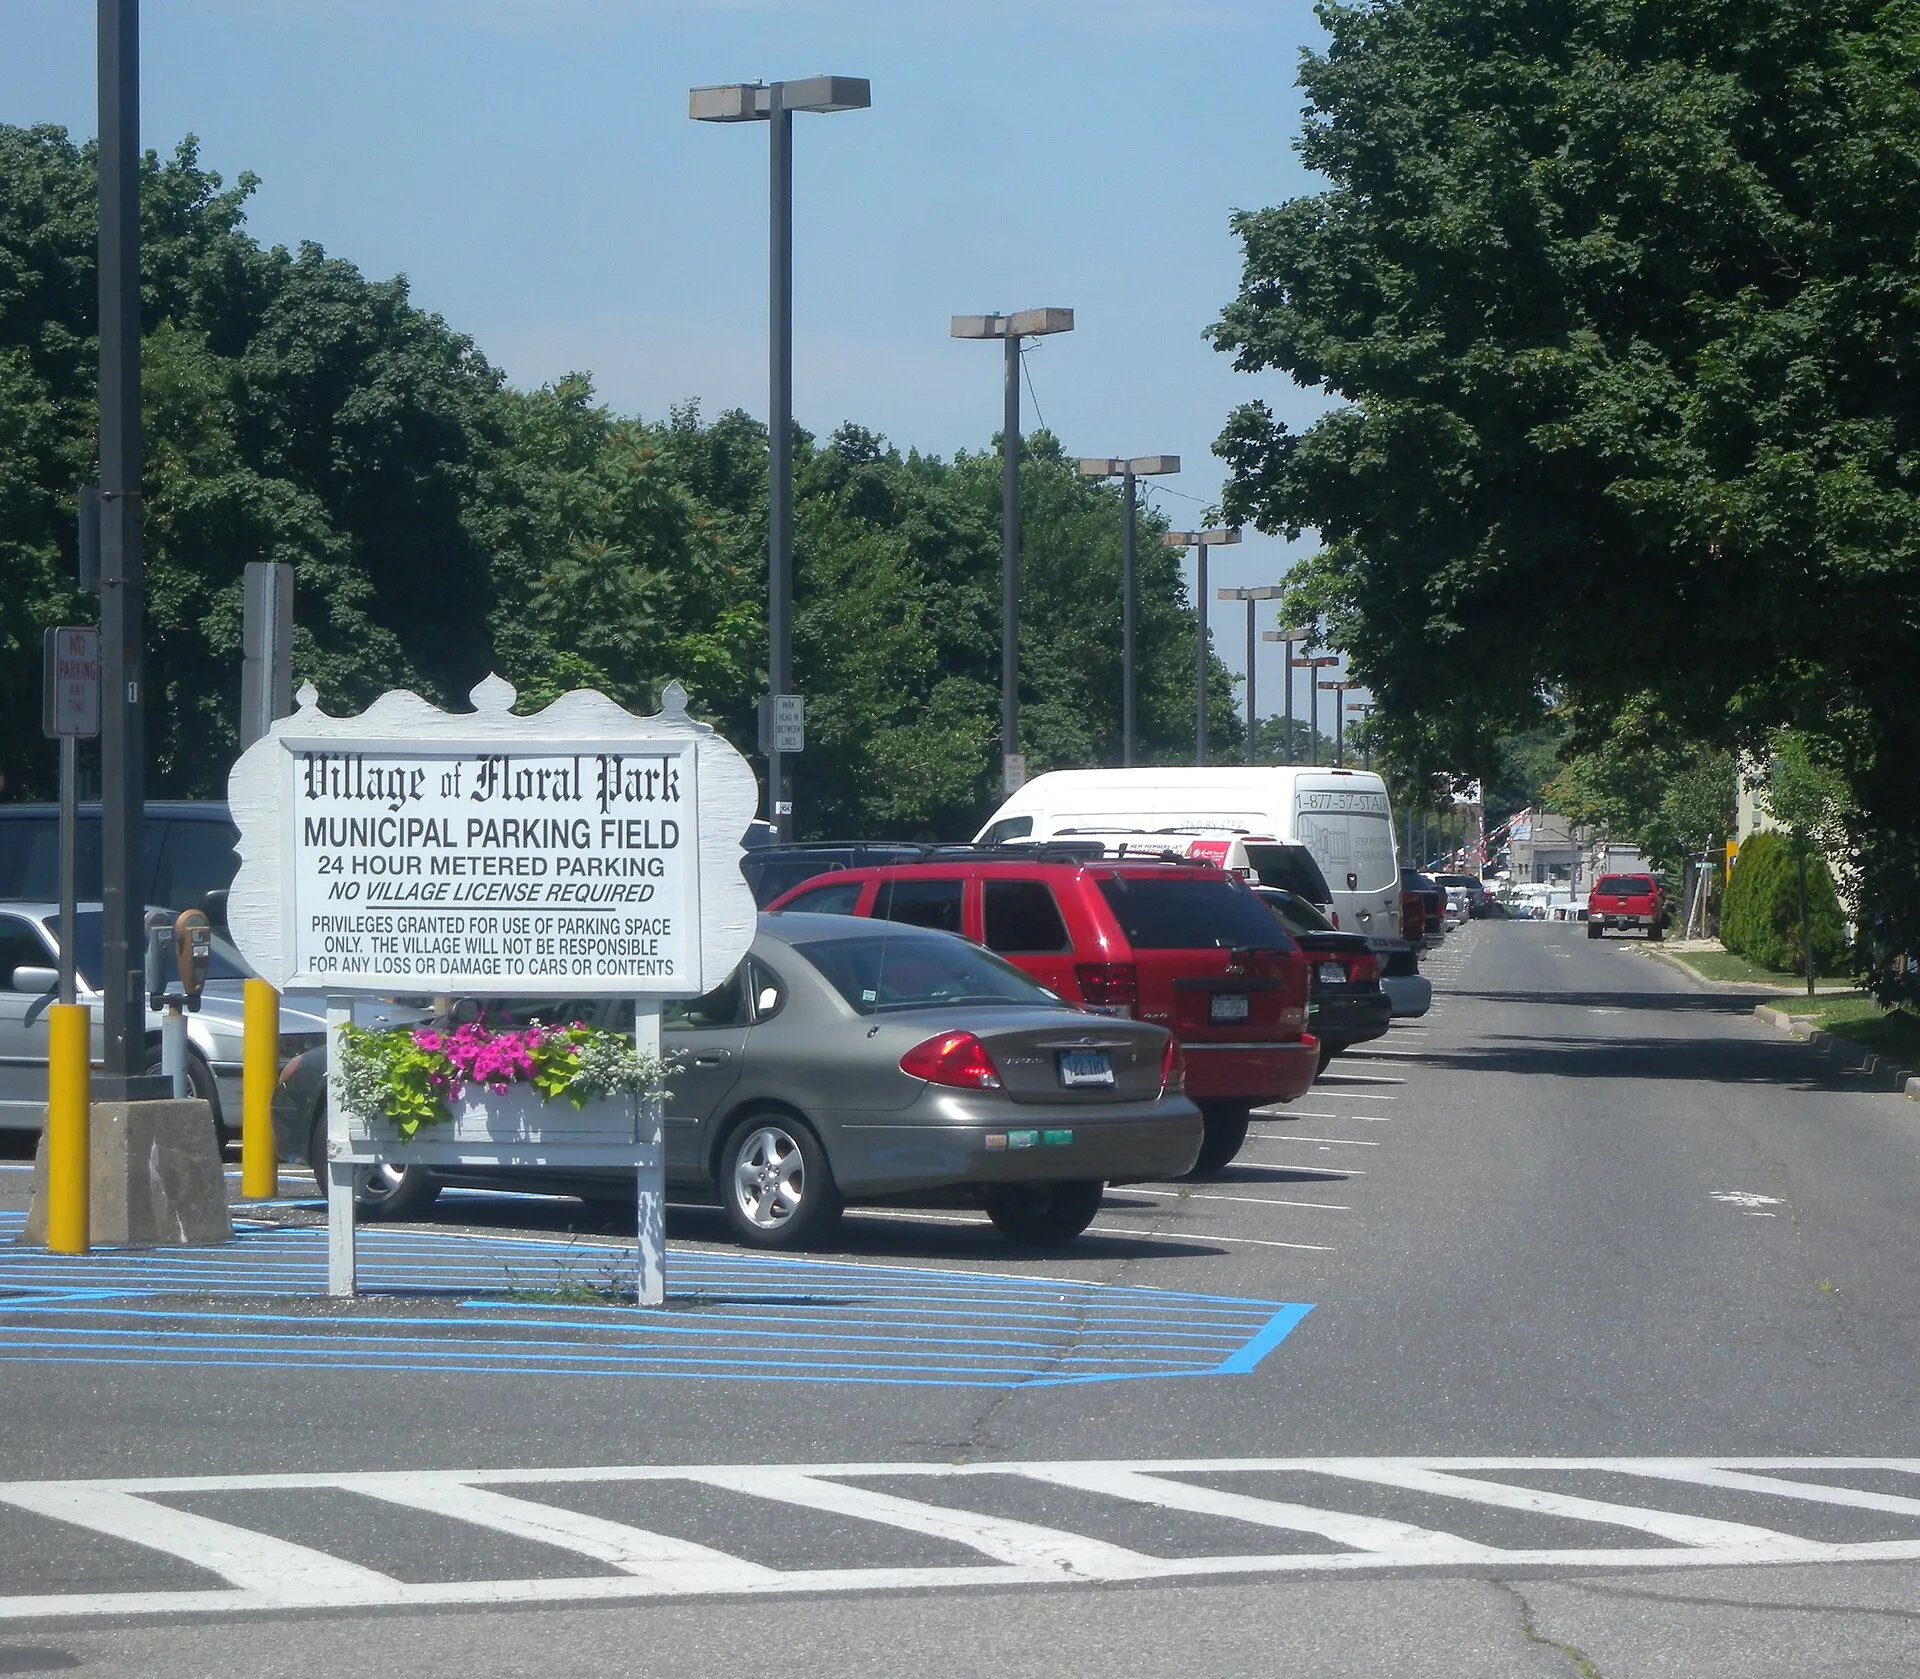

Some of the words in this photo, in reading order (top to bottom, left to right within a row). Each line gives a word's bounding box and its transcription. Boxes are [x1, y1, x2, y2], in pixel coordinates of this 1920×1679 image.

[69, 634, 85, 656] NO
[58, 660, 96, 680] PARKING
[69, 684, 86, 696] ANY
[782, 701, 795, 709] PARK
[779, 713, 792, 721] HEAD
[777, 725, 800, 734] BETWEEN
[782, 737, 796, 746] LINES
[303, 752, 426, 812] Village
[440, 761, 462, 799] of
[470, 754, 583, 802] Floral
[596, 754, 681, 814] Park
[304, 817, 457, 848] MUNICIPAL
[467, 818, 590, 849] PARKING
[601, 819, 680, 849] FIELD
[318, 855, 344, 874] 24
[352, 855, 421, 875] HOUR
[431, 856, 547, 876] METERED
[556, 857, 664, 877] PARKING
[328, 881, 360, 901] NO
[367, 882, 450, 902] VILLAGE
[452, 883, 544, 903] LICENSE
[545, 884, 655, 903] REQUIRED
[312, 916, 394, 933] PRIVILEGES
[397, 916, 465, 934] GRANTED
[469, 917, 498, 934] FOR
[503, 917, 530, 934] USE
[535, 917, 553, 935] OF
[558, 917, 620, 935] PARKING
[625, 918, 671, 935] SPACE
[324, 937, 362, 954] ONLY.
[371, 937, 398, 953] THE
[403, 937, 460, 954] VILLAGE
[465, 937, 498, 954] WILL
[503, 938, 532, 955] NOT
[537, 938, 555, 955] BE
[560, 938, 658, 956] RESPONSIBLE
[310, 957, 337, 973] FOR
[342, 957, 370, 973] ANY
[375, 957, 411, 974] LOSS
[416, 957, 435, 974] OR
[440, 957, 501, 975] DAMAGE
[505, 958, 524, 975] TO
[529, 958, 567, 975] CARS
[572, 959, 592, 975] OR
[597, 959, 674, 976] CONTENTS
